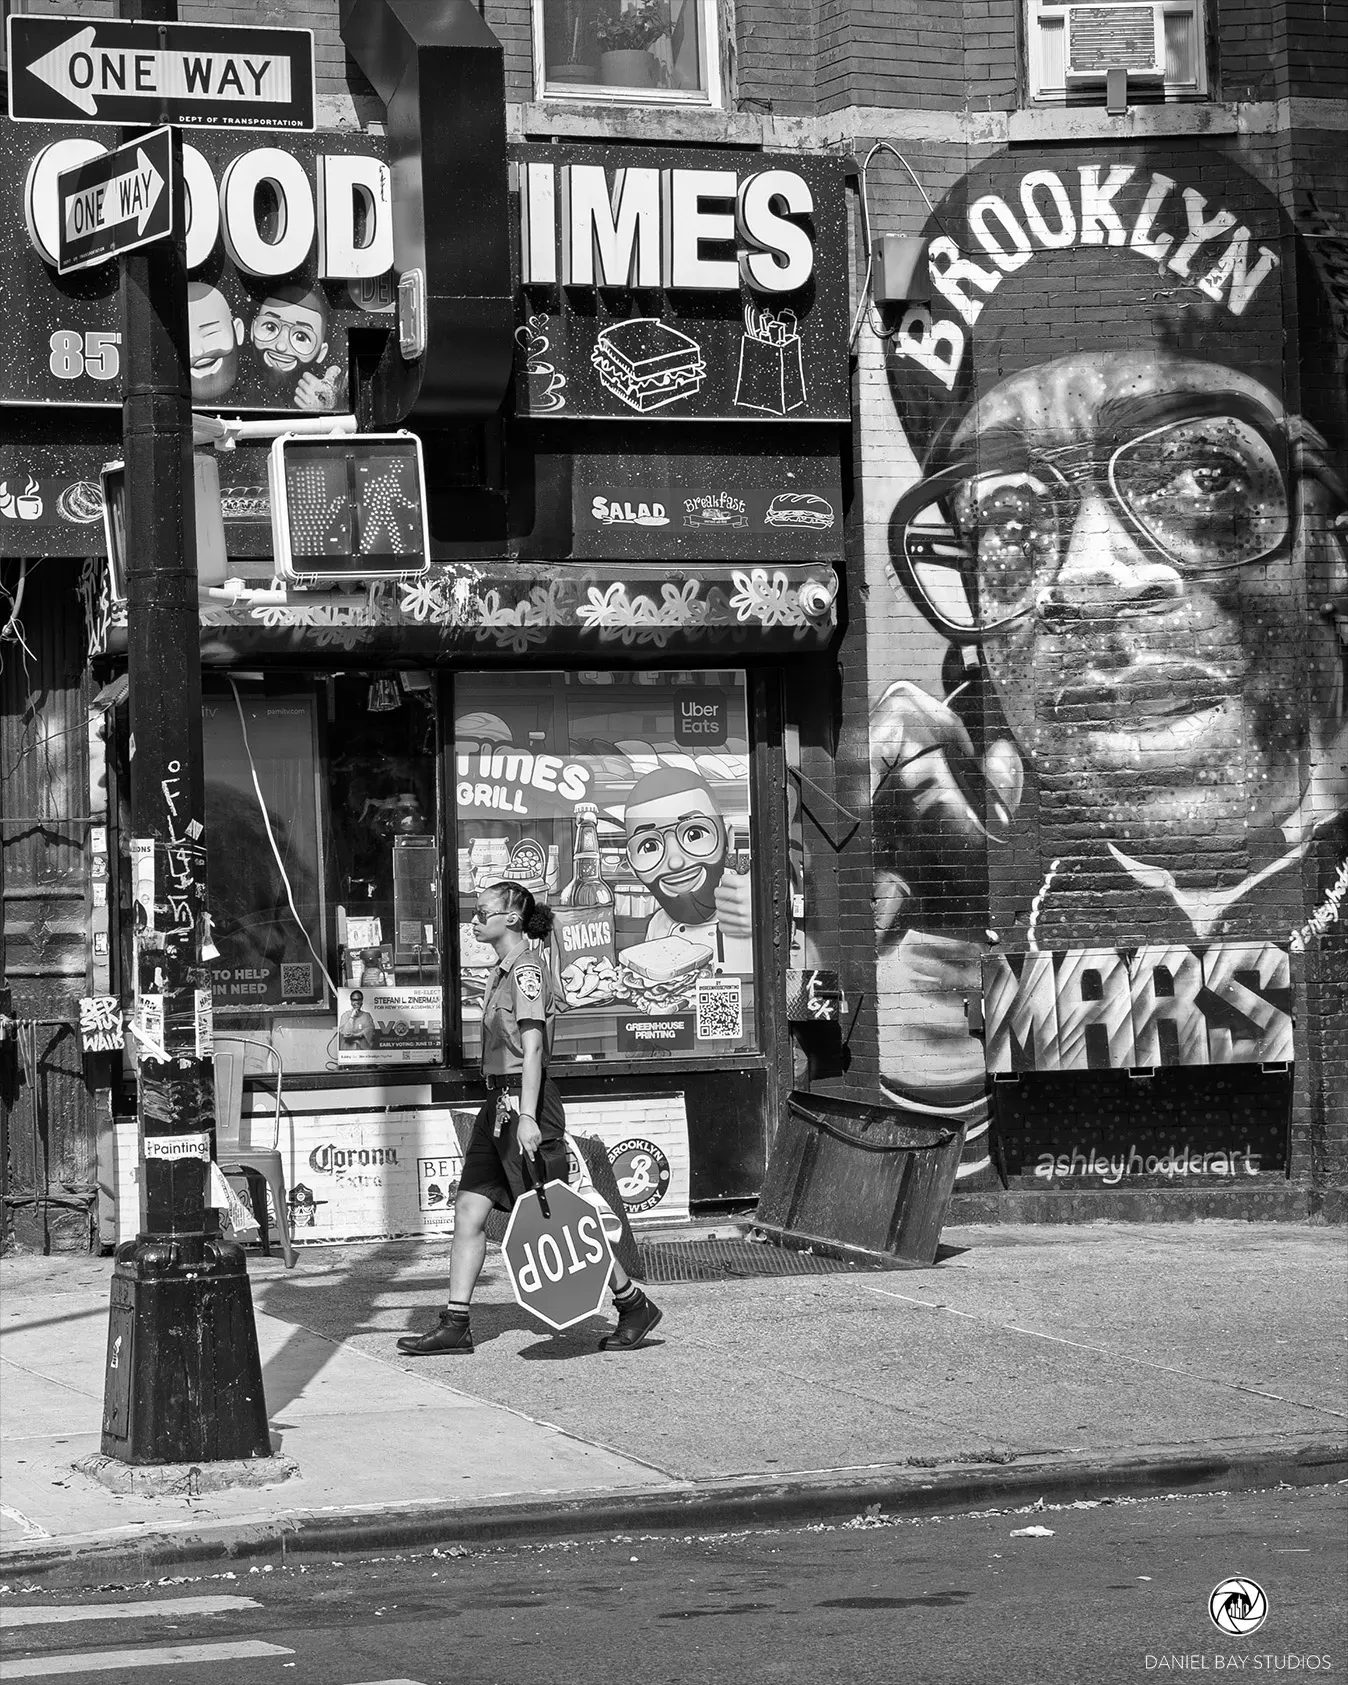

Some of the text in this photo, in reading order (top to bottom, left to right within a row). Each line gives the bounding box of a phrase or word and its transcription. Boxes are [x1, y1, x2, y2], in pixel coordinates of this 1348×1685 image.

[68, 51, 272, 96] ONE WAY
[178, 115, 304, 127] DEPT OF TRANSPORTATION
[73, 168, 154, 235] ONE WAY
[508, 160, 814, 293] IMES
[894, 163, 1281, 392] BROOKLYN
[591, 491, 746, 520] SALAD Breakfast
[680, 702, 719, 717] Uber
[681, 719, 720, 734] Eats
[456, 782, 528, 815] GRILL
[562, 921, 611, 952] SNACKS
[212, 968, 270, 980] TO HELP
[212, 983, 268, 995] IN NEED
[981, 942, 1295, 1073] MARS
[376, 1020, 441, 1037] VOTE
[625, 1021, 685, 1032] GREENHOUSE
[635, 1030, 676, 1040] PRINTING
[153, 1142, 206, 1155] Painting
[308, 1143, 399, 1176] Corona
[607, 1140, 663, 1165] BROOKLYN
[518, 1215, 604, 1294] STOP
